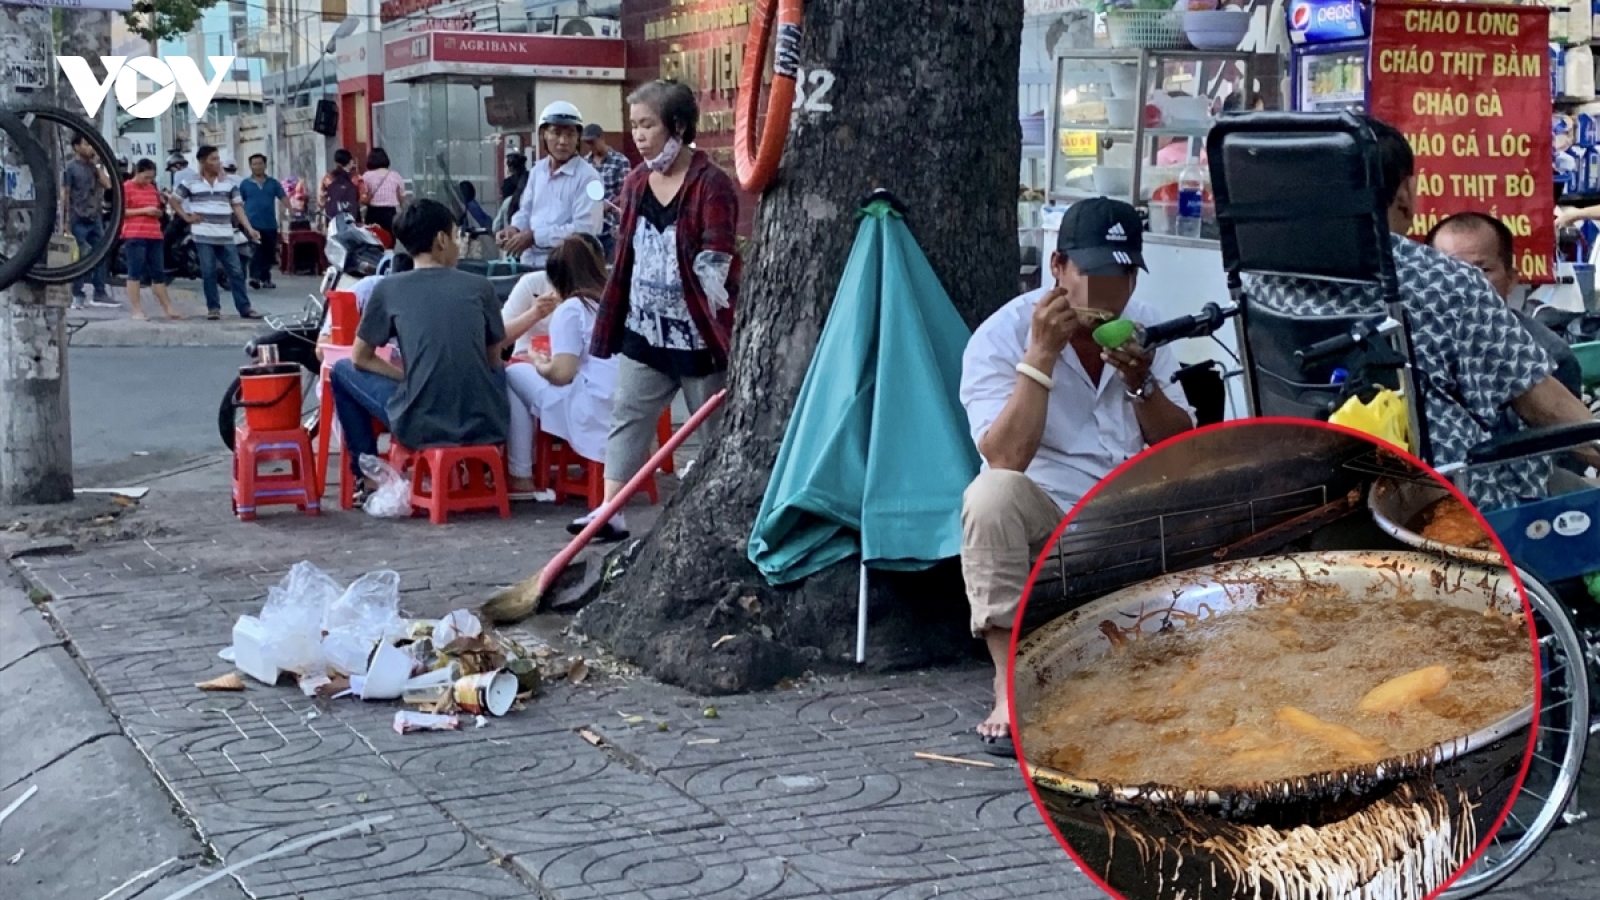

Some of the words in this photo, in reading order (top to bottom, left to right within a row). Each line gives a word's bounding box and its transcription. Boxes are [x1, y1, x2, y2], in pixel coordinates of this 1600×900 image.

[1317, 0, 1354, 28] pepsi
[459, 39, 528, 53] AGRIBANK
[1380, 44, 1434, 74] CHÁO
[1440, 52, 1487, 81] THỊT
[1493, 44, 1541, 77] BẰM
[1412, 87, 1469, 117] CHÁO
[1475, 88, 1503, 117] GÀ
[1403, 127, 1445, 156] HÁO
[1452, 128, 1480, 157] CÁ
[1487, 128, 1531, 157] LÓC
[1416, 168, 1445, 197] ÁO
[1449, 174, 1497, 203] THỊT
[1505, 168, 1535, 197] BÒ
